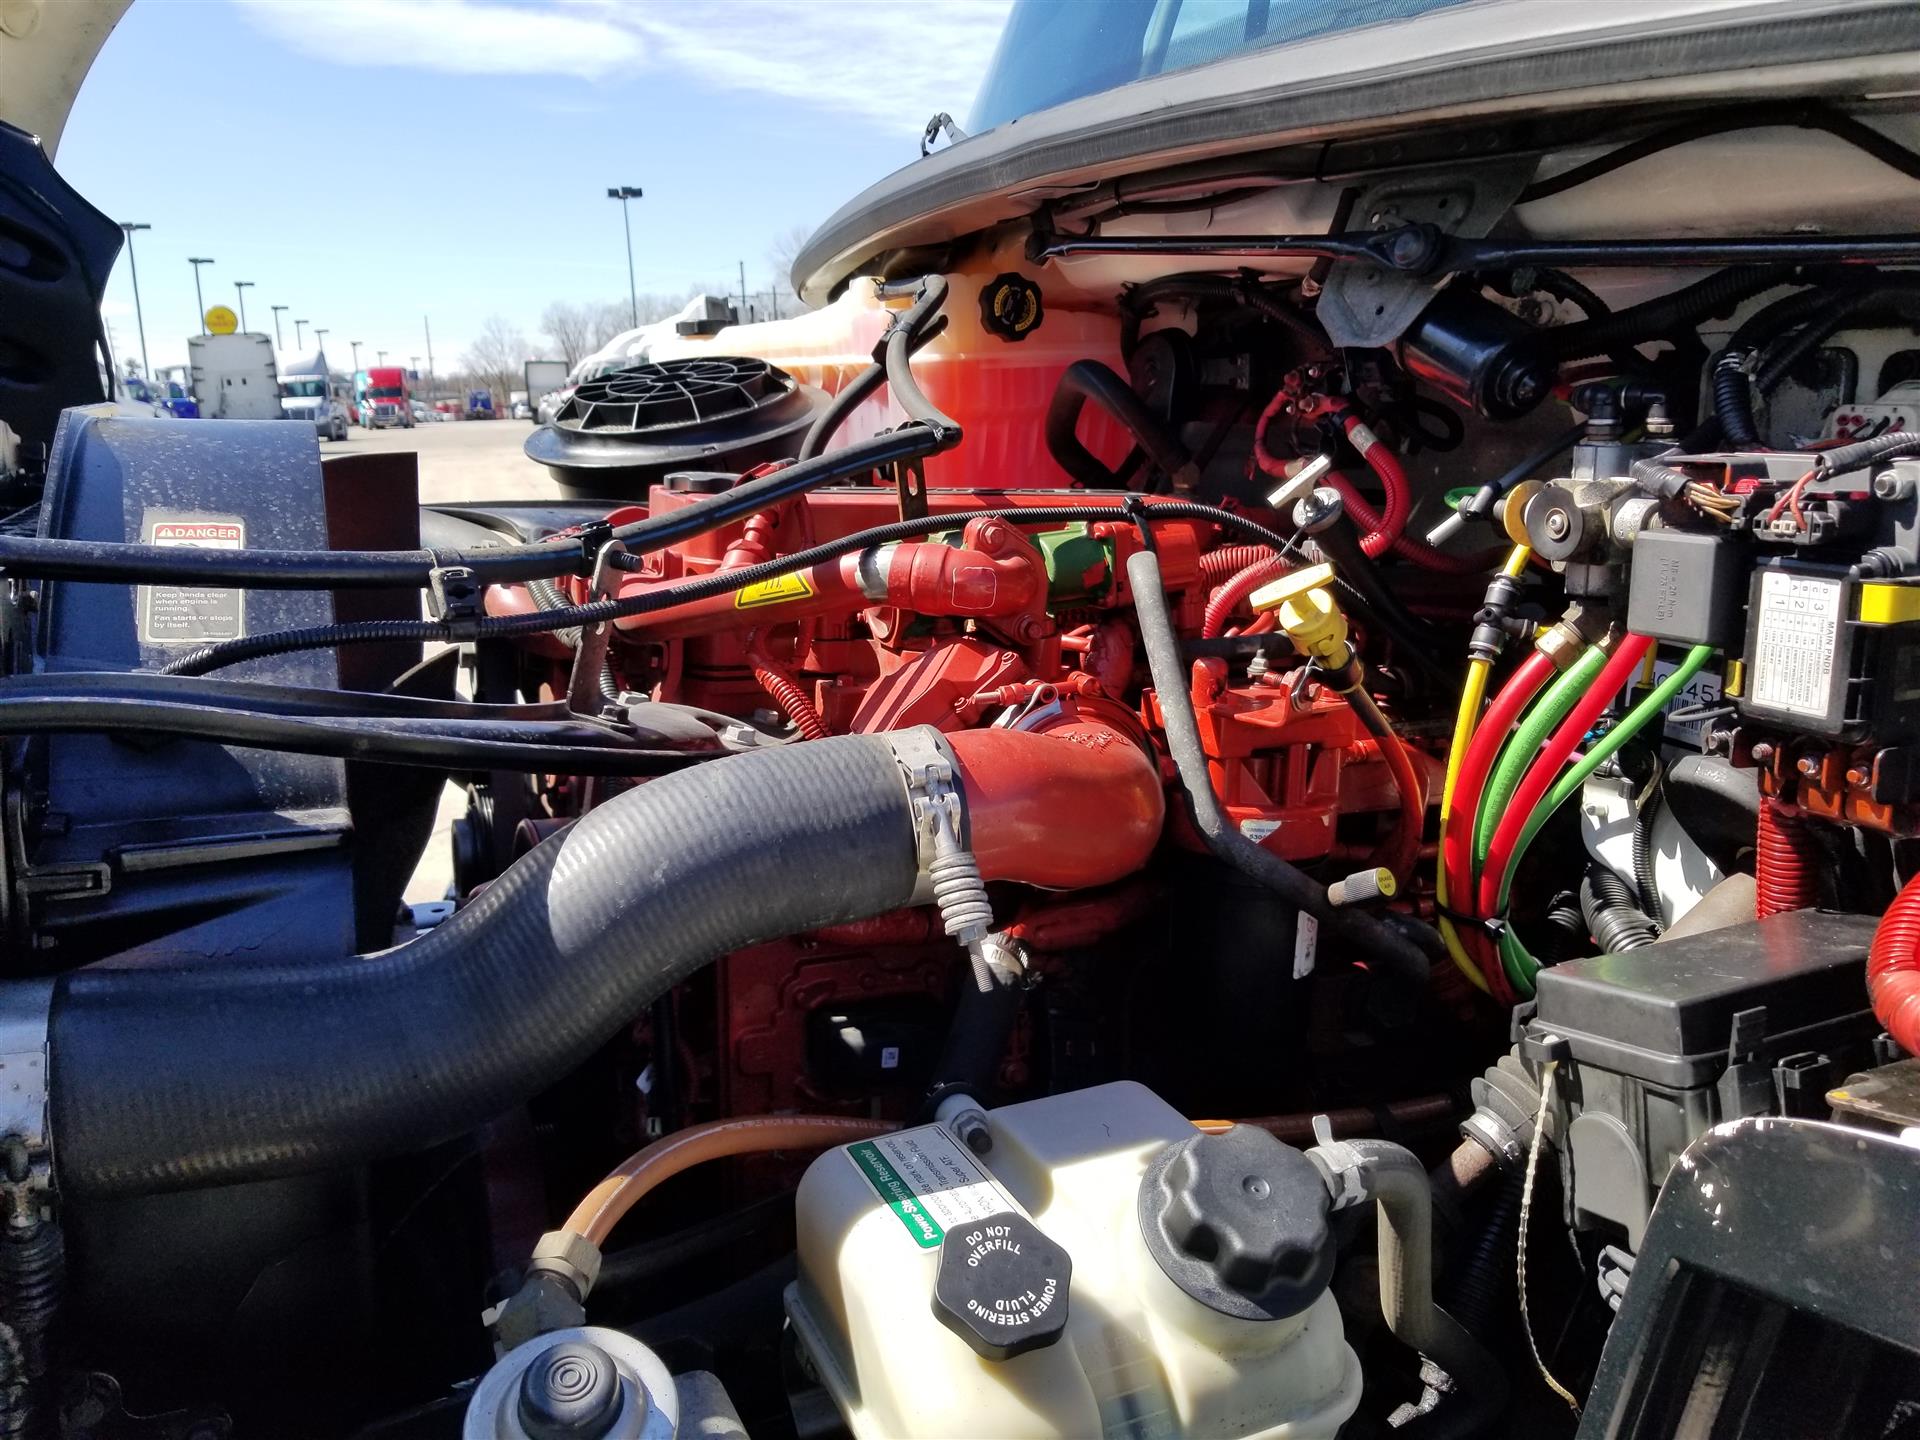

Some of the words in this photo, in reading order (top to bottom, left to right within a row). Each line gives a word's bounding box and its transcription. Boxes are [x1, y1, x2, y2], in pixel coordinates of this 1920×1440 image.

[174, 528, 238, 538] DANGER
[156, 591, 177, 599] Keep
[1795, 601, 1804, 609] 2
[1813, 603, 1823, 611] 3
[154, 621, 164, 629] by
[166, 621, 190, 629] itself.
[1825, 621, 1836, 645] MAIN
[1823, 648, 1833, 675] PNDB
[905, 1139, 919, 1153] Fluid
[861, 1148, 893, 1182] Reservoir
[903, 1161, 914, 1171] on
[917, 1152, 950, 1187] Transmission
[950, 1166, 970, 1183] Super
[911, 1169, 924, 1185] mark
[888, 1180, 918, 1214] Steering
[912, 1213, 938, 1241] Power
[965, 1229, 983, 1245] DO
[986, 1226, 1011, 1238] NOT
[967, 1239, 1022, 1268] OVERFILL
[995, 1290, 1036, 1311] FLUID
[1028, 1278, 1056, 1319] POWER
[967, 1298, 1030, 1326] STEERING
